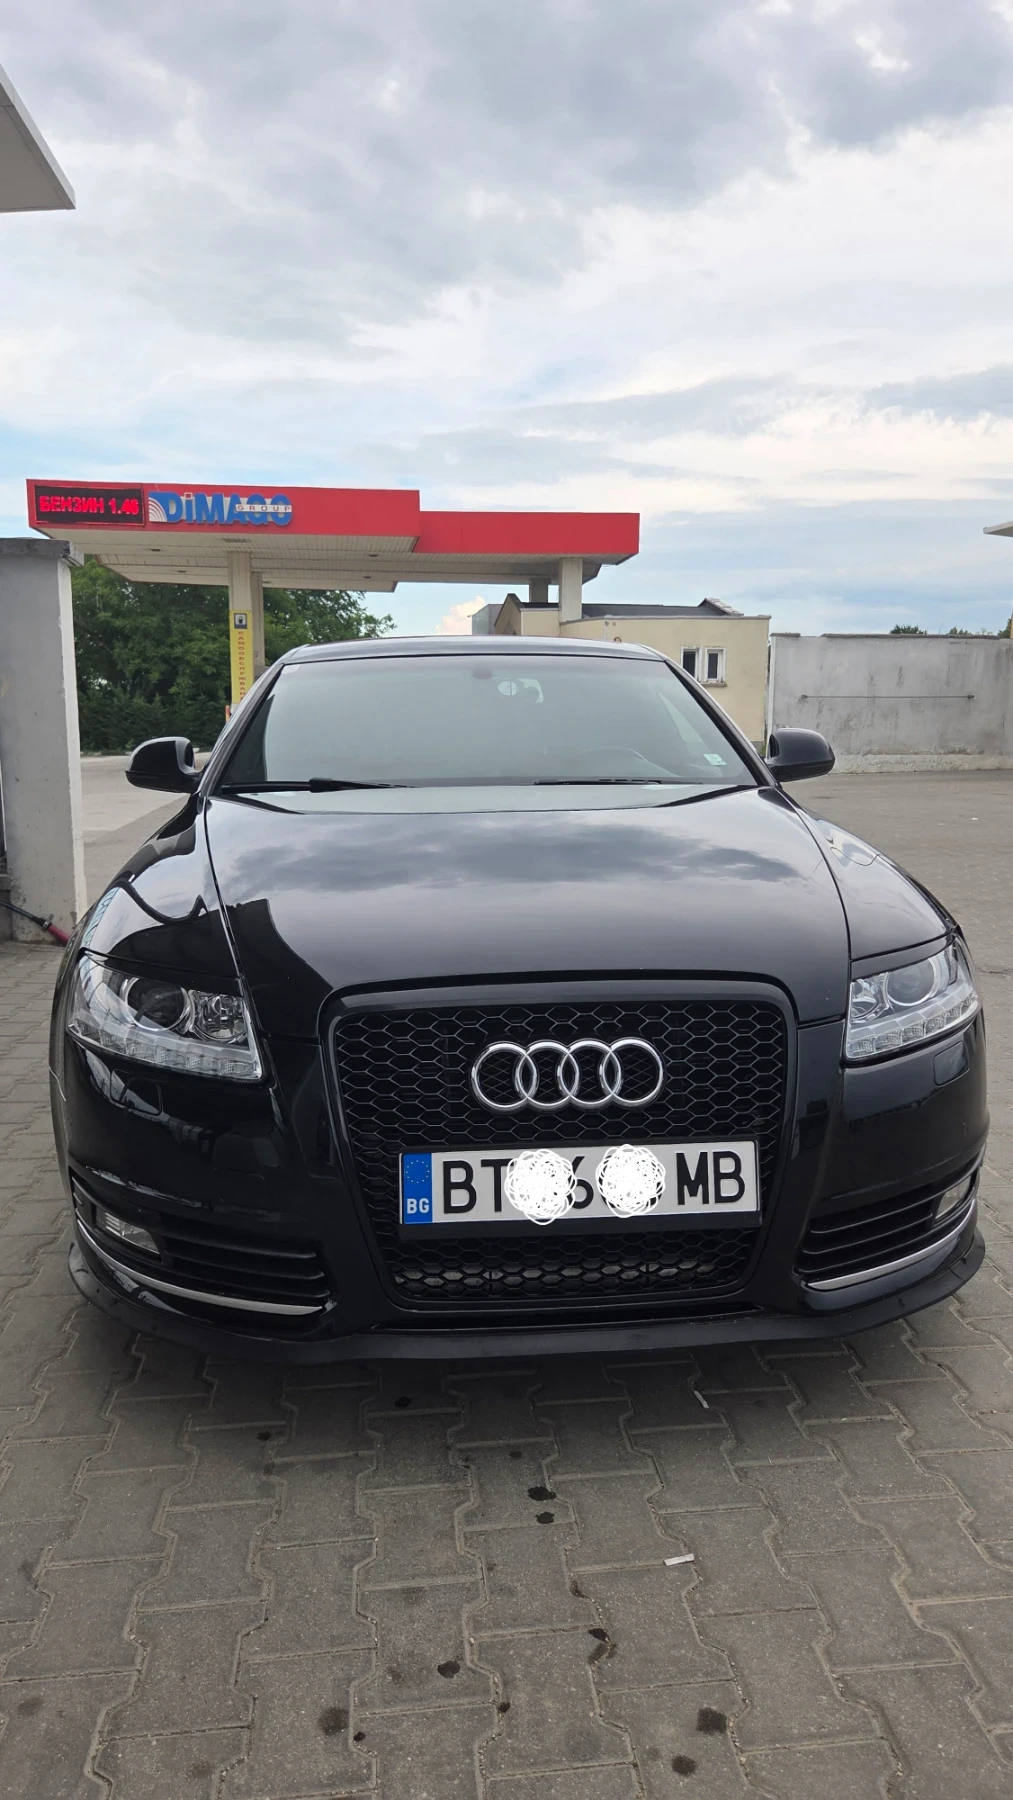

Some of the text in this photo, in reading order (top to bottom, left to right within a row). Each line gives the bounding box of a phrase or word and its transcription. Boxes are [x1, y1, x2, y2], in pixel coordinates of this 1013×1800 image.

[39, 495, 104, 513] БЕНЗИН
[237, 504, 291, 512] GROUP
[674, 1150, 746, 1206] MB
[406, 1198, 430, 1214] BG
